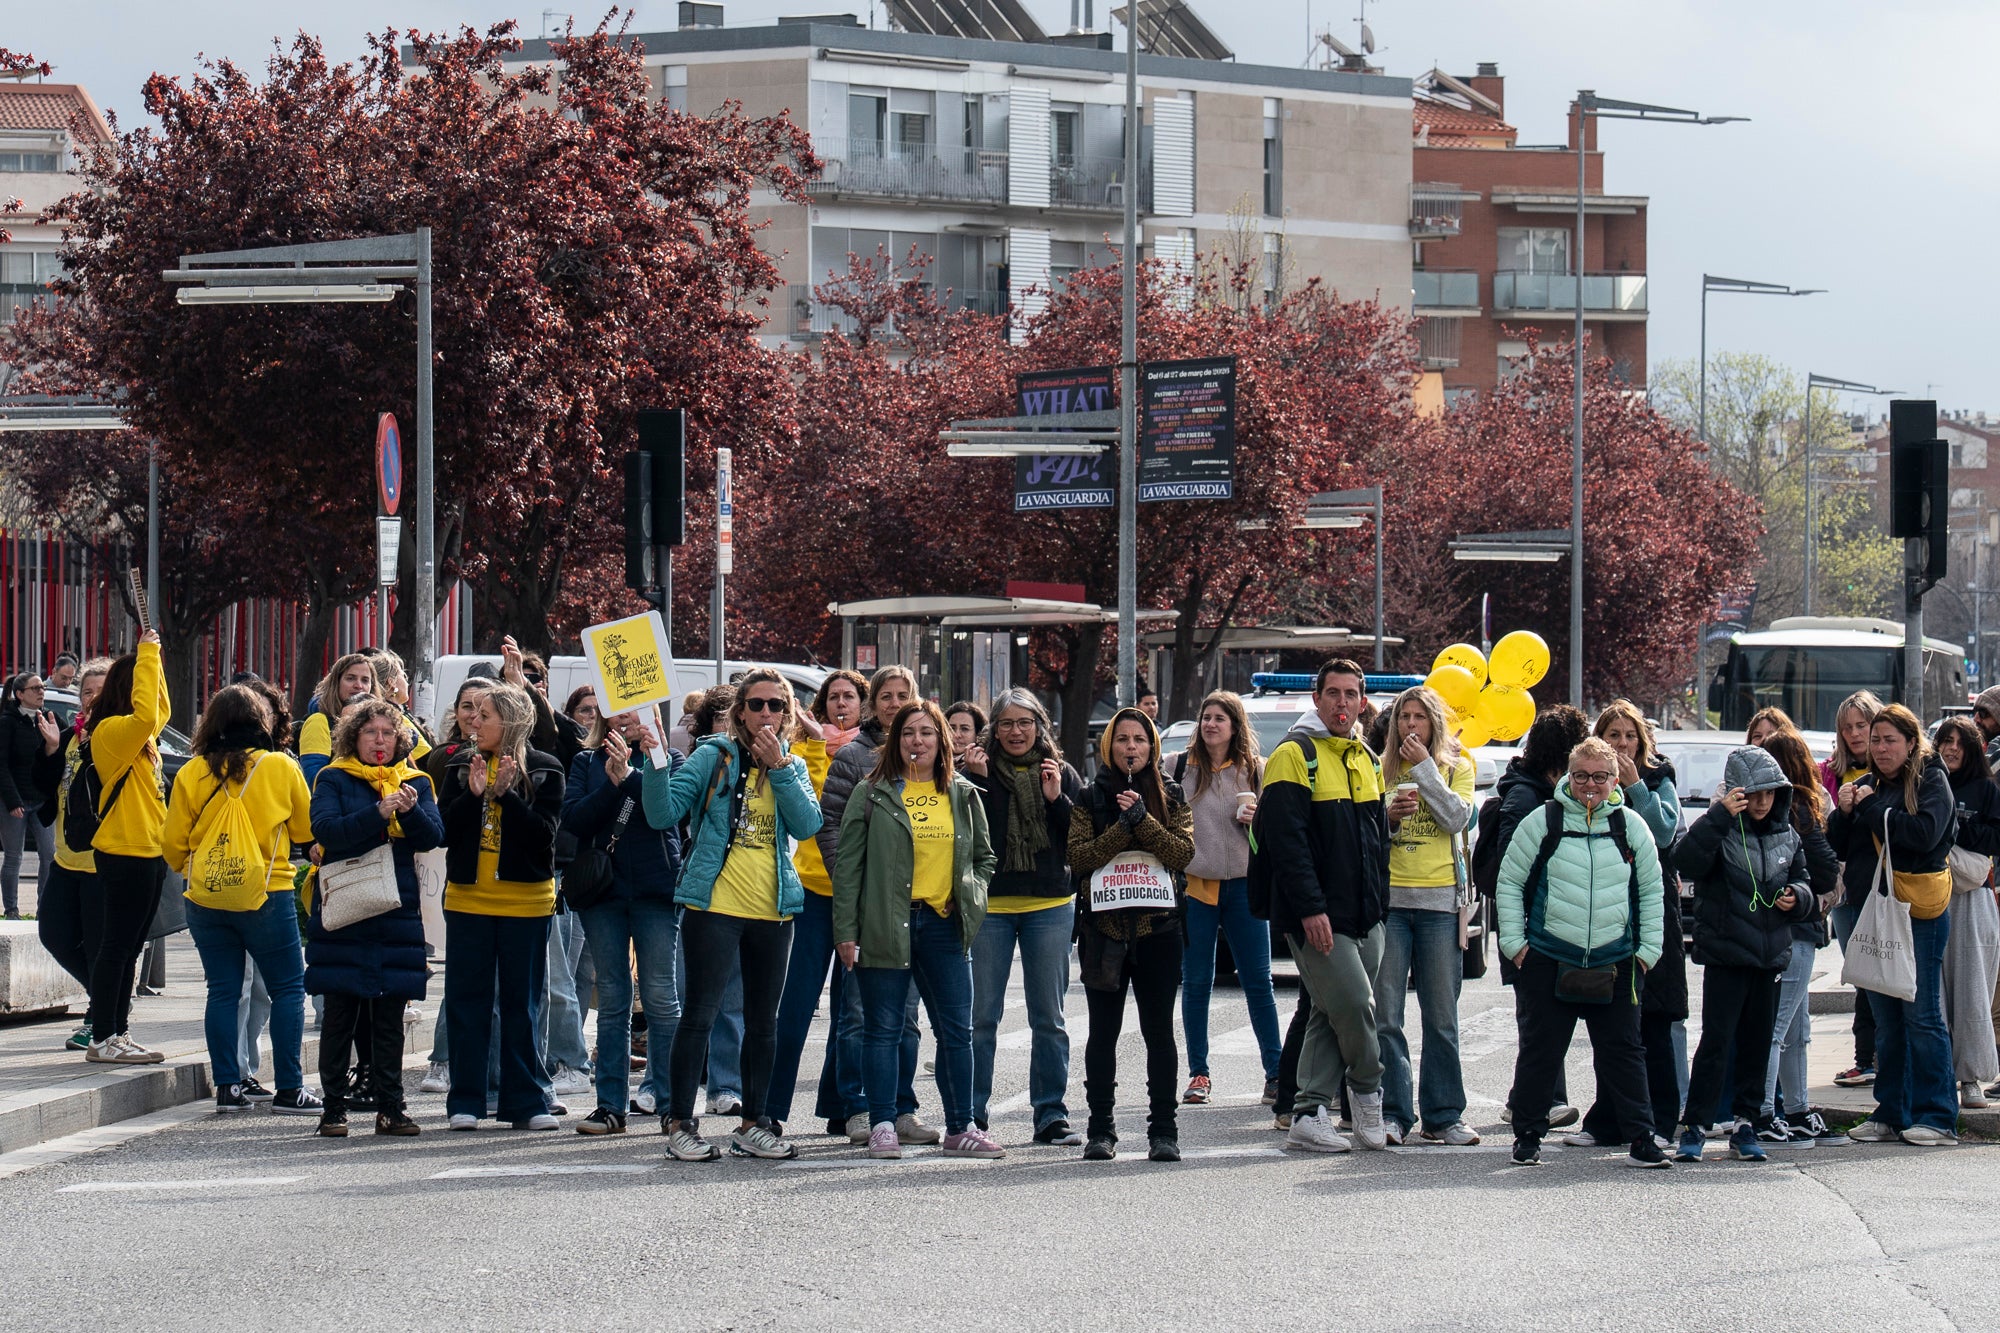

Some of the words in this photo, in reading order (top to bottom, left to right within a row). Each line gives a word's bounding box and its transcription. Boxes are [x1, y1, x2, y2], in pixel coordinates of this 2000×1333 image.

[1188, 370, 1203, 378] març
[1032, 380, 1059, 388] Festival
[1022, 386, 1108, 417] WHAT
[1143, 488, 1155, 498] LA
[1155, 484, 1228, 496] VANGUARDIA
[1033, 492, 1110, 506] VANGUARDIA
[905, 795, 938, 807] SOS
[1114, 863, 1149, 875] MENYS
[1093, 887, 1116, 904] MÉS
[1120, 887, 1173, 900] EDUCACIÓ.
[1852, 934, 1870, 944] ALL
[1880, 940, 1903, 951] LOVE
[1860, 945, 1877, 957] FOR
